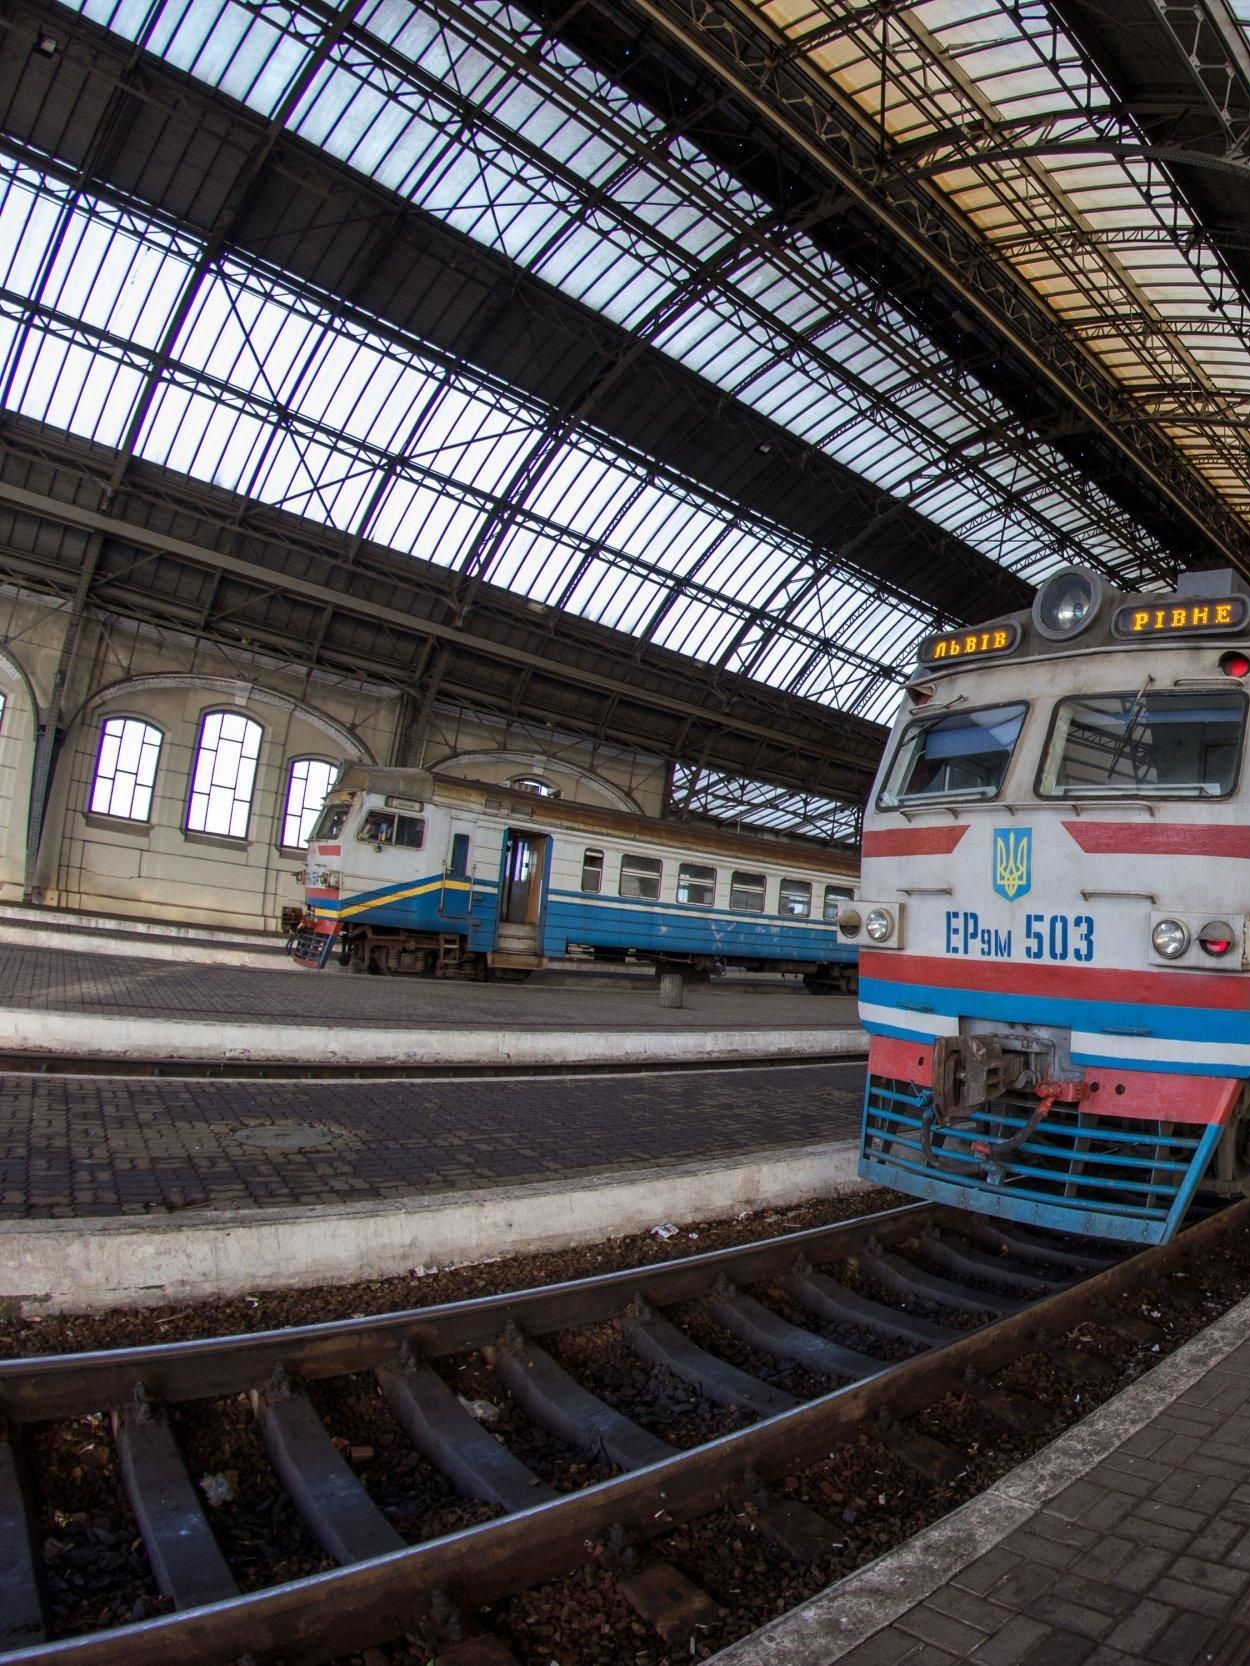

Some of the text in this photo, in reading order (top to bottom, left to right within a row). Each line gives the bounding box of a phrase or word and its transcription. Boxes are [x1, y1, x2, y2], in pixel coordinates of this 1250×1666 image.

[1133, 604, 1233, 631] РІВНЕ
[934, 630, 1007, 659] ЛЬВІВ
[1025, 914, 1095, 962] 503
